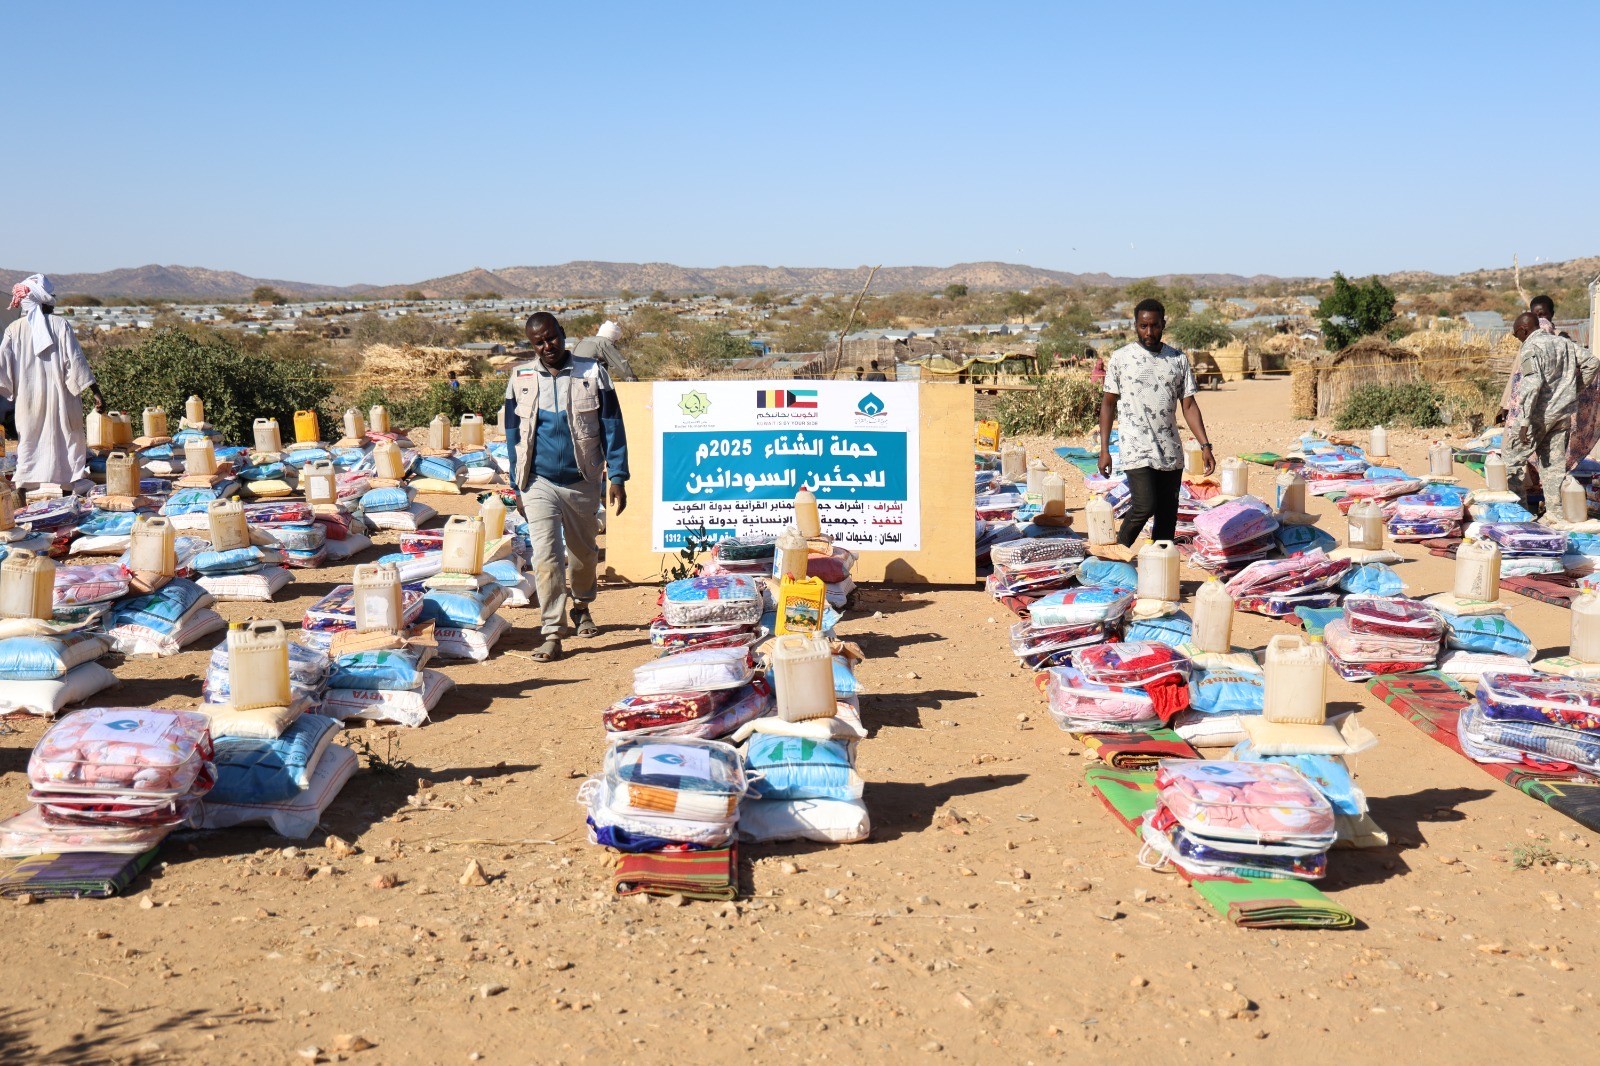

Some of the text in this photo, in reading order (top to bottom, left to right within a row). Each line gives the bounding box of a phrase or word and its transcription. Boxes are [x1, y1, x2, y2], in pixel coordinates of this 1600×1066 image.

[764, 433, 824, 459] الشتاء
[829, 435, 878, 459] حملة
[685, 465, 886, 494] للاجئين السودانين
[672, 503, 706, 513] الكويت
[708, 501, 732, 513] بدولة
[834, 500, 864, 513] إشراف
[873, 500, 903, 513] إشراف
[675, 515, 705, 526] تشاد
[708, 515, 738, 527] بدولة
[742, 514, 793, 527] الإنسانية
[820, 514, 858, 526] جمعية
[871, 516, 903, 527] تنفيذ
[664, 533, 681, 543] 1312
[845, 531, 873, 544] مخيمات
[878, 532, 902, 545] المكان
